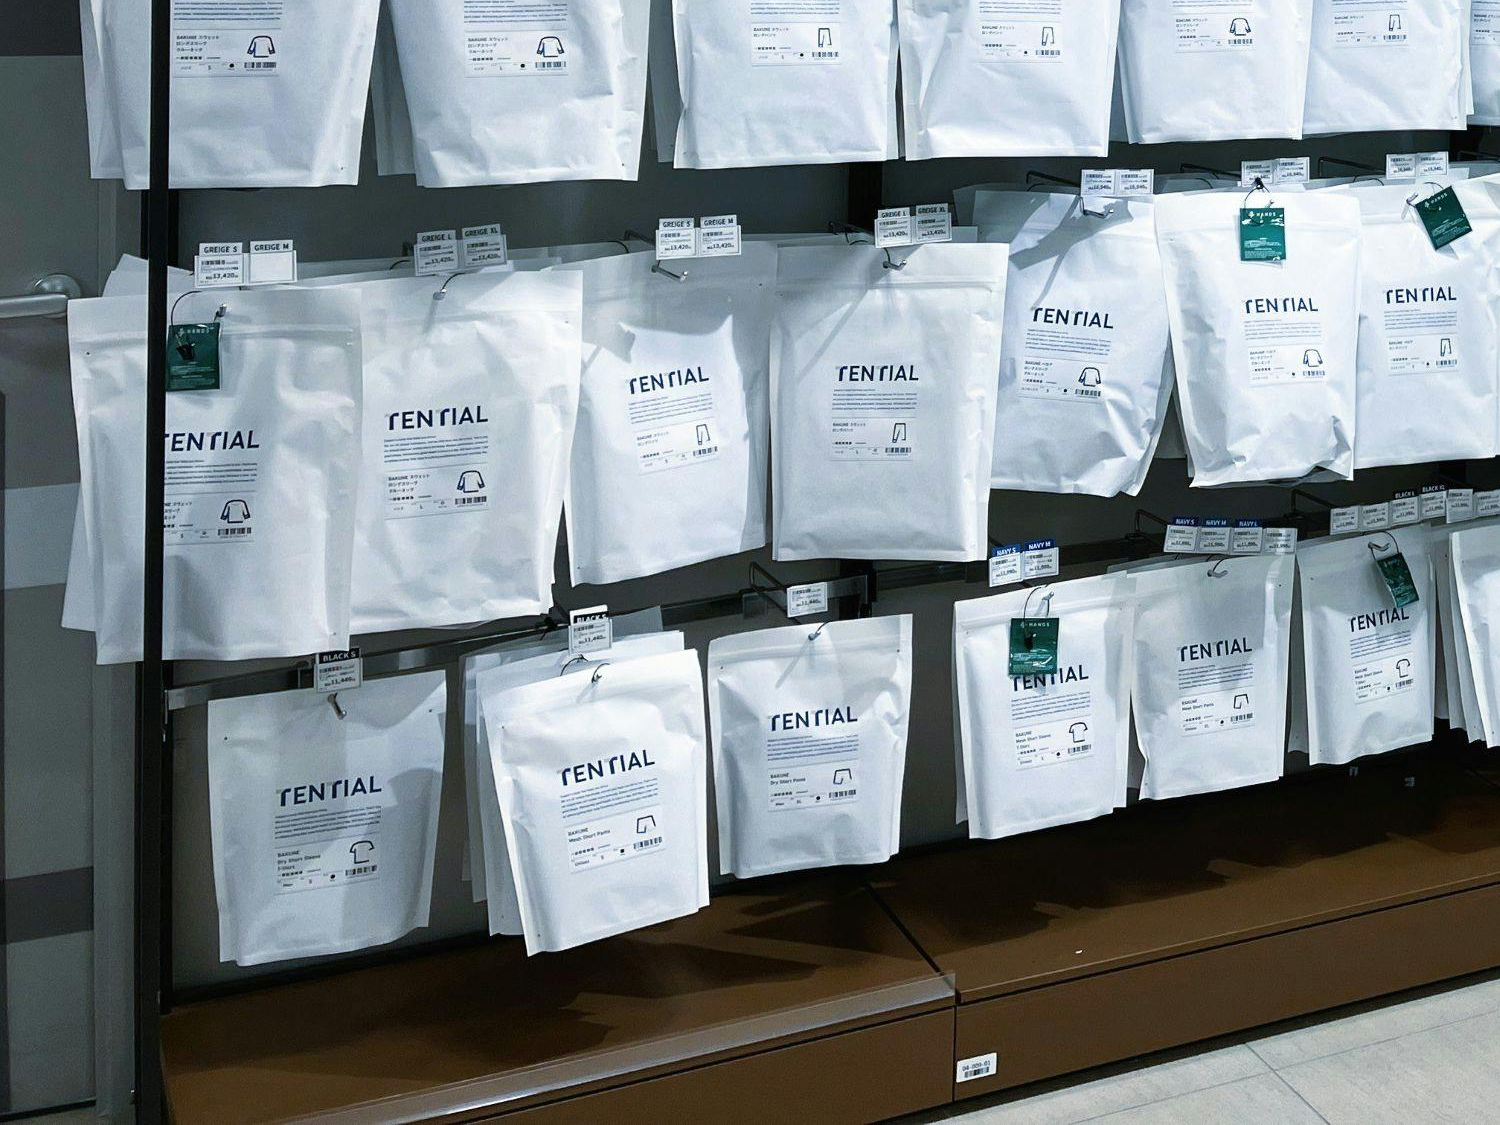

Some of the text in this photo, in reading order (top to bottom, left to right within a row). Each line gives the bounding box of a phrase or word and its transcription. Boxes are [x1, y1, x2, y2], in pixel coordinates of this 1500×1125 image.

[662, 220, 685, 228] GREIGE
[703, 218, 727, 227] GREIGE
[421, 234, 446, 243] GREIGE
[464, 228, 488, 237] GREIGE
[203, 246, 231, 254] GREIGE
[254, 244, 281, 252] GREIGE
[1387, 287, 1456, 304] TENTIAL
[1246, 298, 1318, 313] TENTIAL
[1033, 308, 1113, 328] TENTIAL
[630, 367, 709, 394] TENTIAL
[839, 365, 918, 381] TENTIAL
[389, 406, 488, 430] TENTIAL
[1028, 542, 1046, 550] NAVY
[1350, 607, 1409, 633] TENTIAL
[323, 653, 349, 662] BLACK
[1180, 637, 1252, 662] TENTIAL
[772, 706, 857, 731] TENTIAL
[562, 750, 655, 785] TENTIAL
[281, 776, 381, 806] TENTIAL
